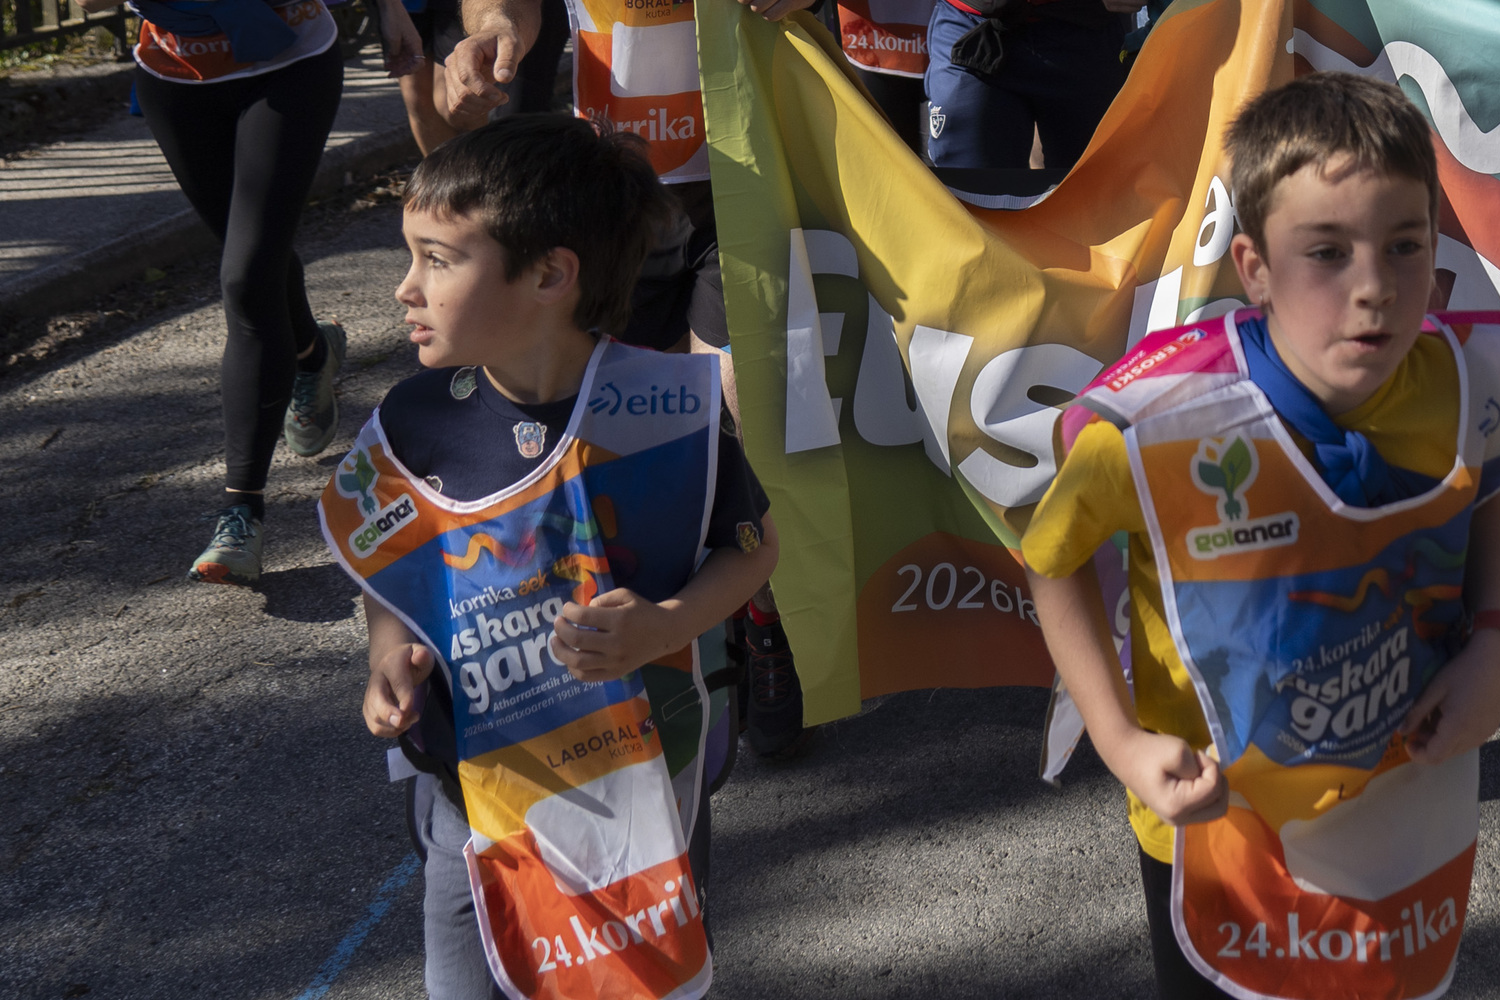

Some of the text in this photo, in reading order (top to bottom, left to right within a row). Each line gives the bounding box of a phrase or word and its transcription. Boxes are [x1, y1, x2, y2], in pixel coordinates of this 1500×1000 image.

[645, 9, 671, 19] kutxa
[1111, 343, 1179, 391] EROSKI
[626, 384, 700, 416] eitb
[353, 498, 415, 553] goiener
[1194, 518, 1294, 553] goiener
[518, 569, 549, 596] aek
[492, 677, 561, 713] Atharratzetik
[495, 697, 555, 727] martxoaren
[556, 684, 582, 702] 19tik
[1290, 656, 1411, 742] gara
[547, 724, 638, 769] LABORAL
[609, 742, 644, 760] kutxa
[1216, 897, 1458, 964] 24.korrika
